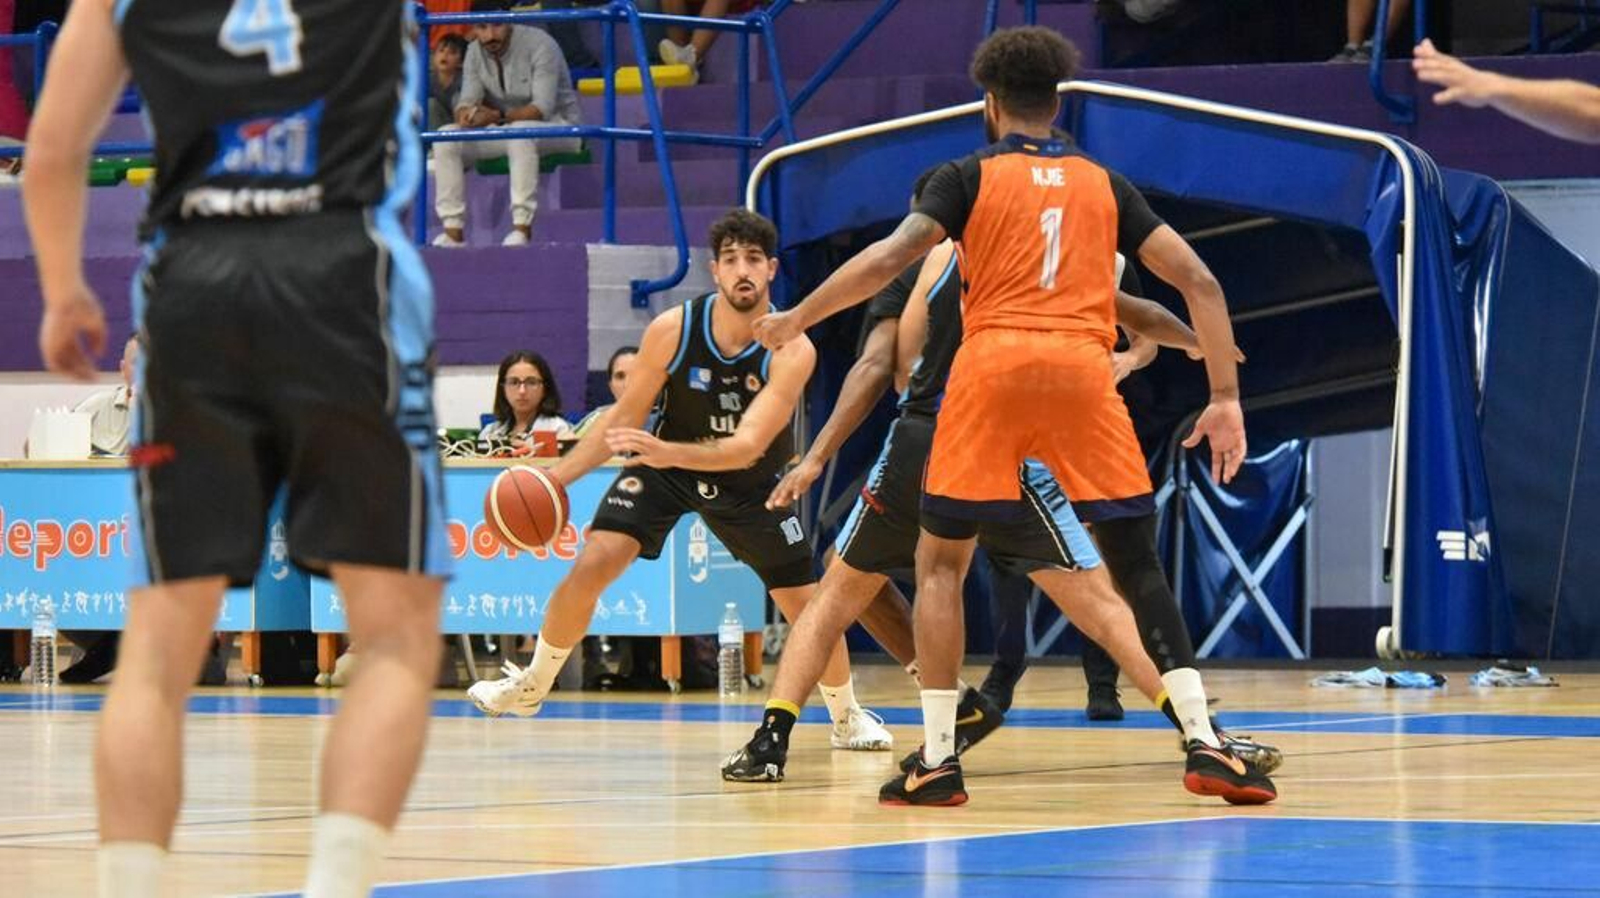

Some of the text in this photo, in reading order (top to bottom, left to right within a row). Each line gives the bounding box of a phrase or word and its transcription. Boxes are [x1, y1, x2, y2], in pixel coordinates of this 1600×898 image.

[218, 0, 304, 76] 4
[1031, 166, 1066, 187] NJIE
[1039, 207, 1063, 290] 1
[719, 392, 742, 412] 10
[780, 516, 804, 546] 10
